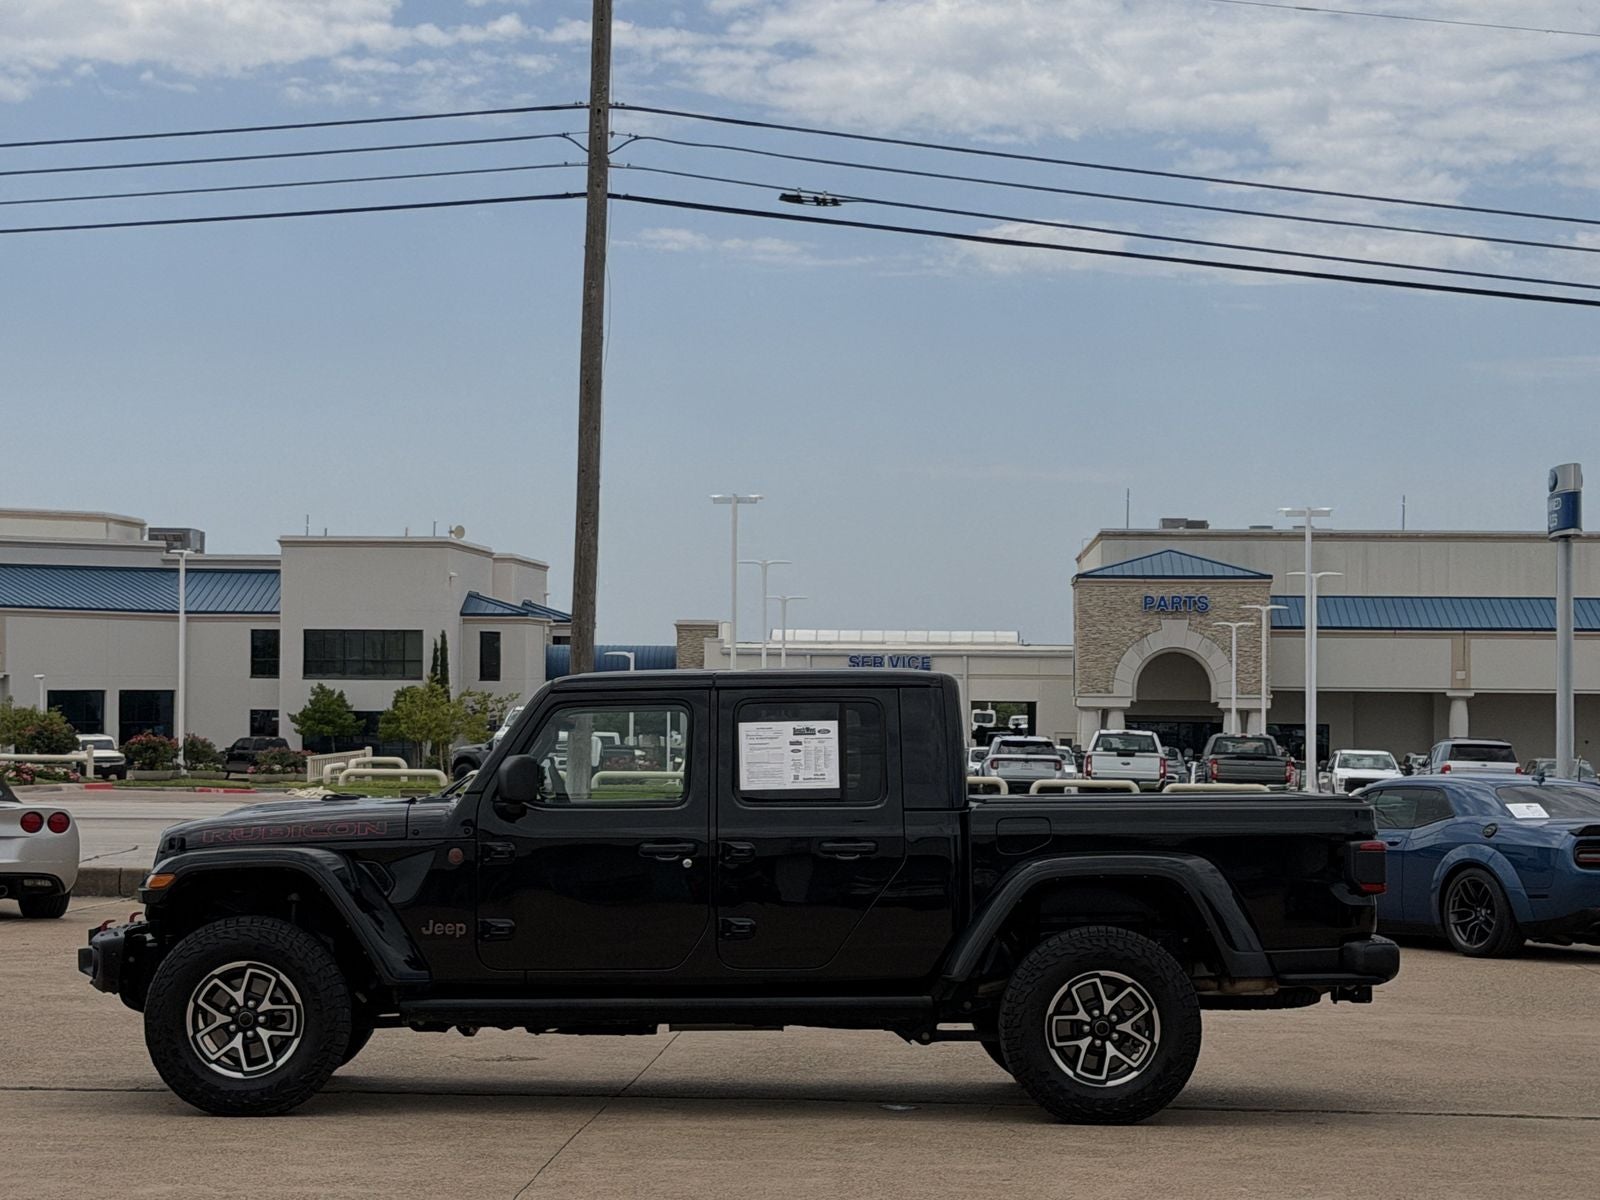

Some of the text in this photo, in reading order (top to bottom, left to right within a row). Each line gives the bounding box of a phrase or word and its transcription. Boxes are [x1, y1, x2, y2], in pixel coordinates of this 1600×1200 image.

[1143, 594, 1210, 611] PARTS
[848, 655, 932, 671] SERVICE
[202, 821, 388, 843] RUBICON
[419, 919, 467, 938] Jeep
